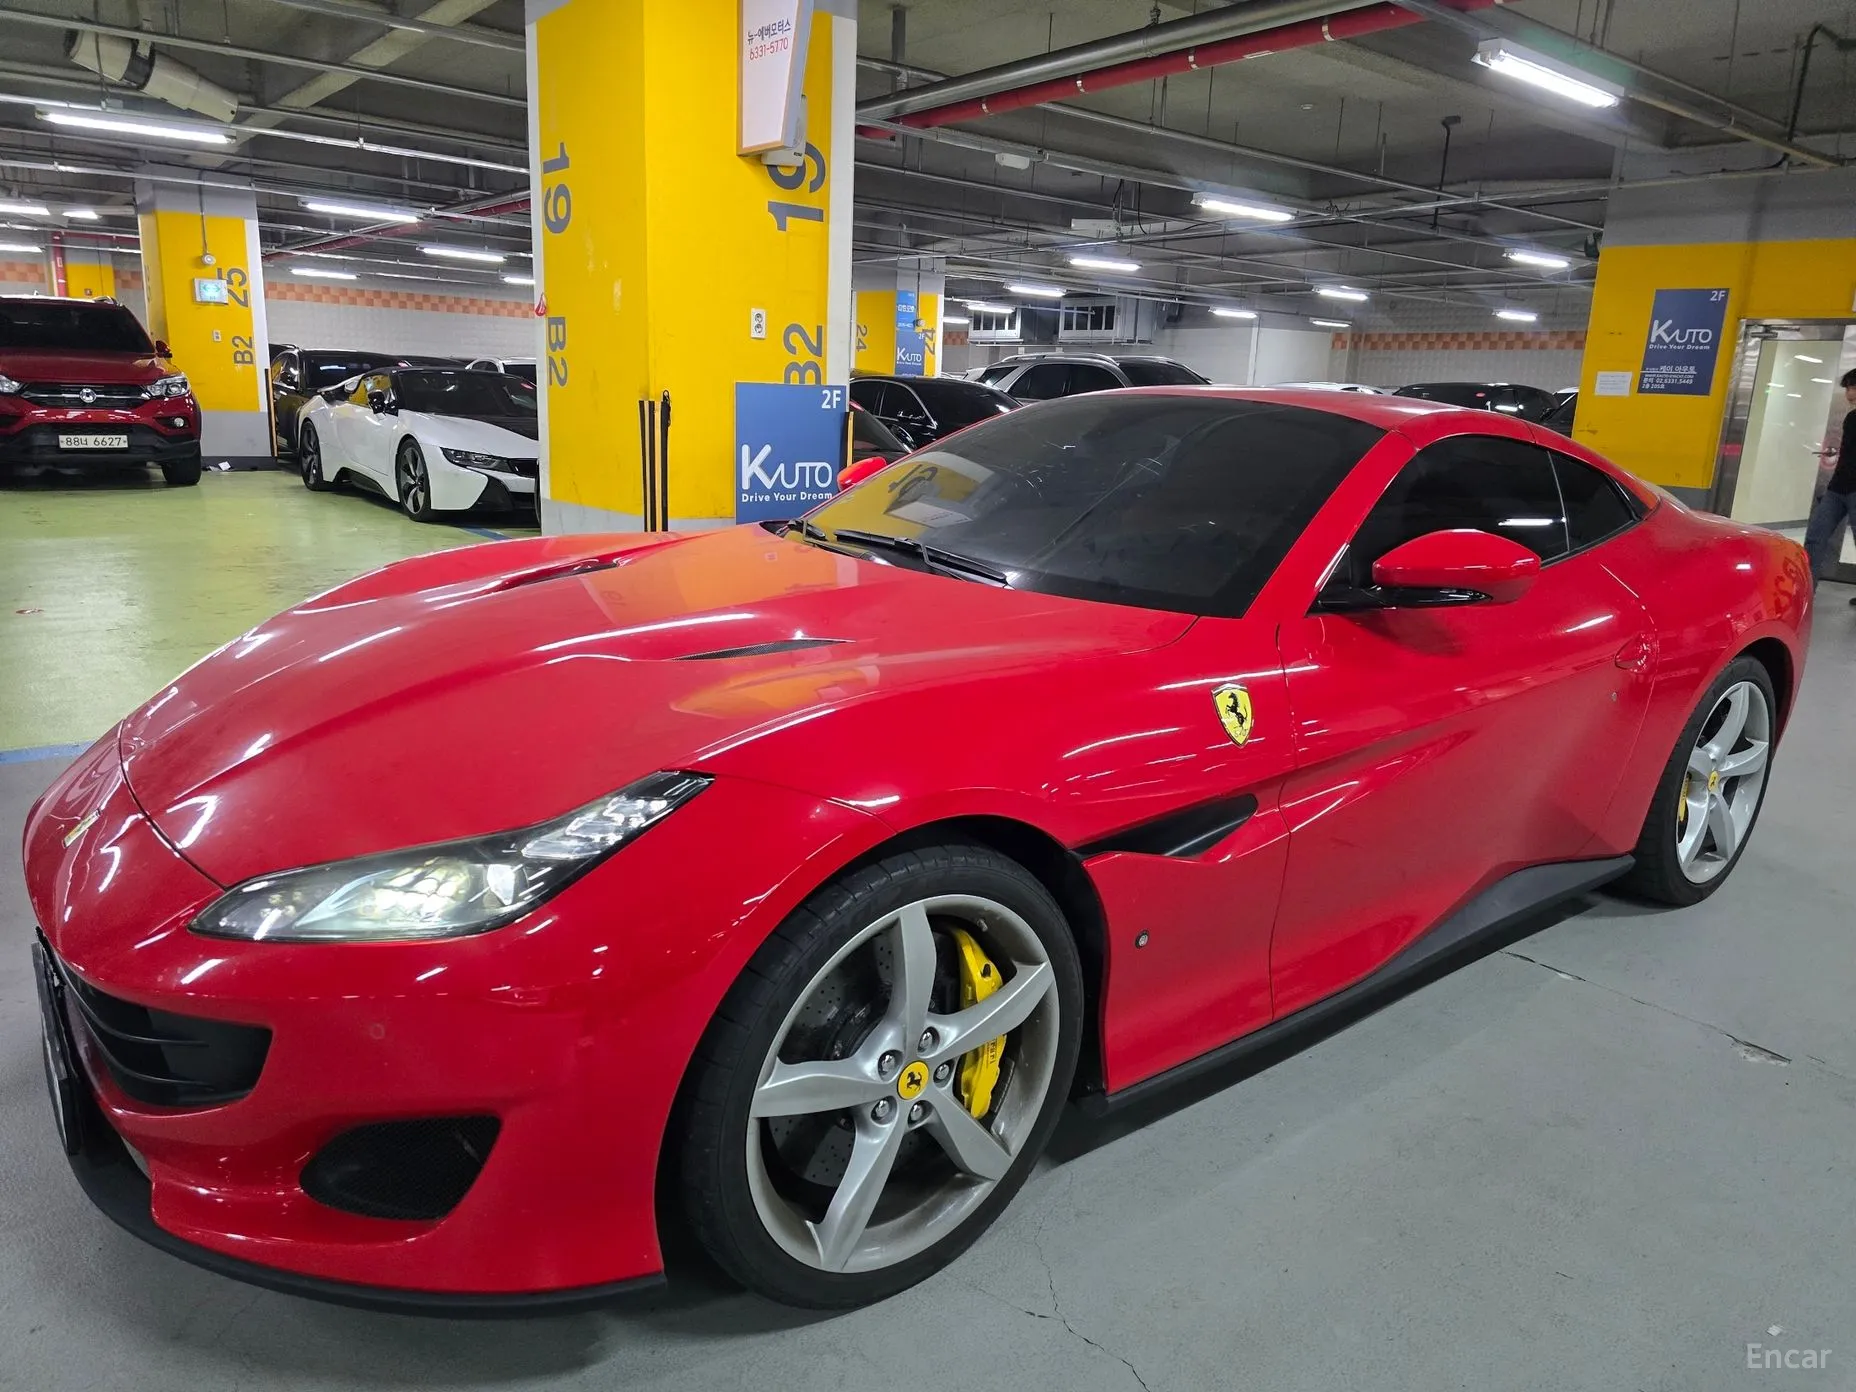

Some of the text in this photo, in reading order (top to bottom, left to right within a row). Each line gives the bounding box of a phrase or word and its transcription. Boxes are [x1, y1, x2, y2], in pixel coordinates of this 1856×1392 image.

[749, 37, 789, 61] 6331-5770
[543, 142, 571, 234] 19
[1710, 290, 1726, 301] 2F
[232, 335, 254, 365] B2
[548, 316, 569, 388] B2
[821, 389, 841, 409] 2F
[93, 437, 122, 446] 6627
[742, 491, 833, 502] Drive Your Dream
